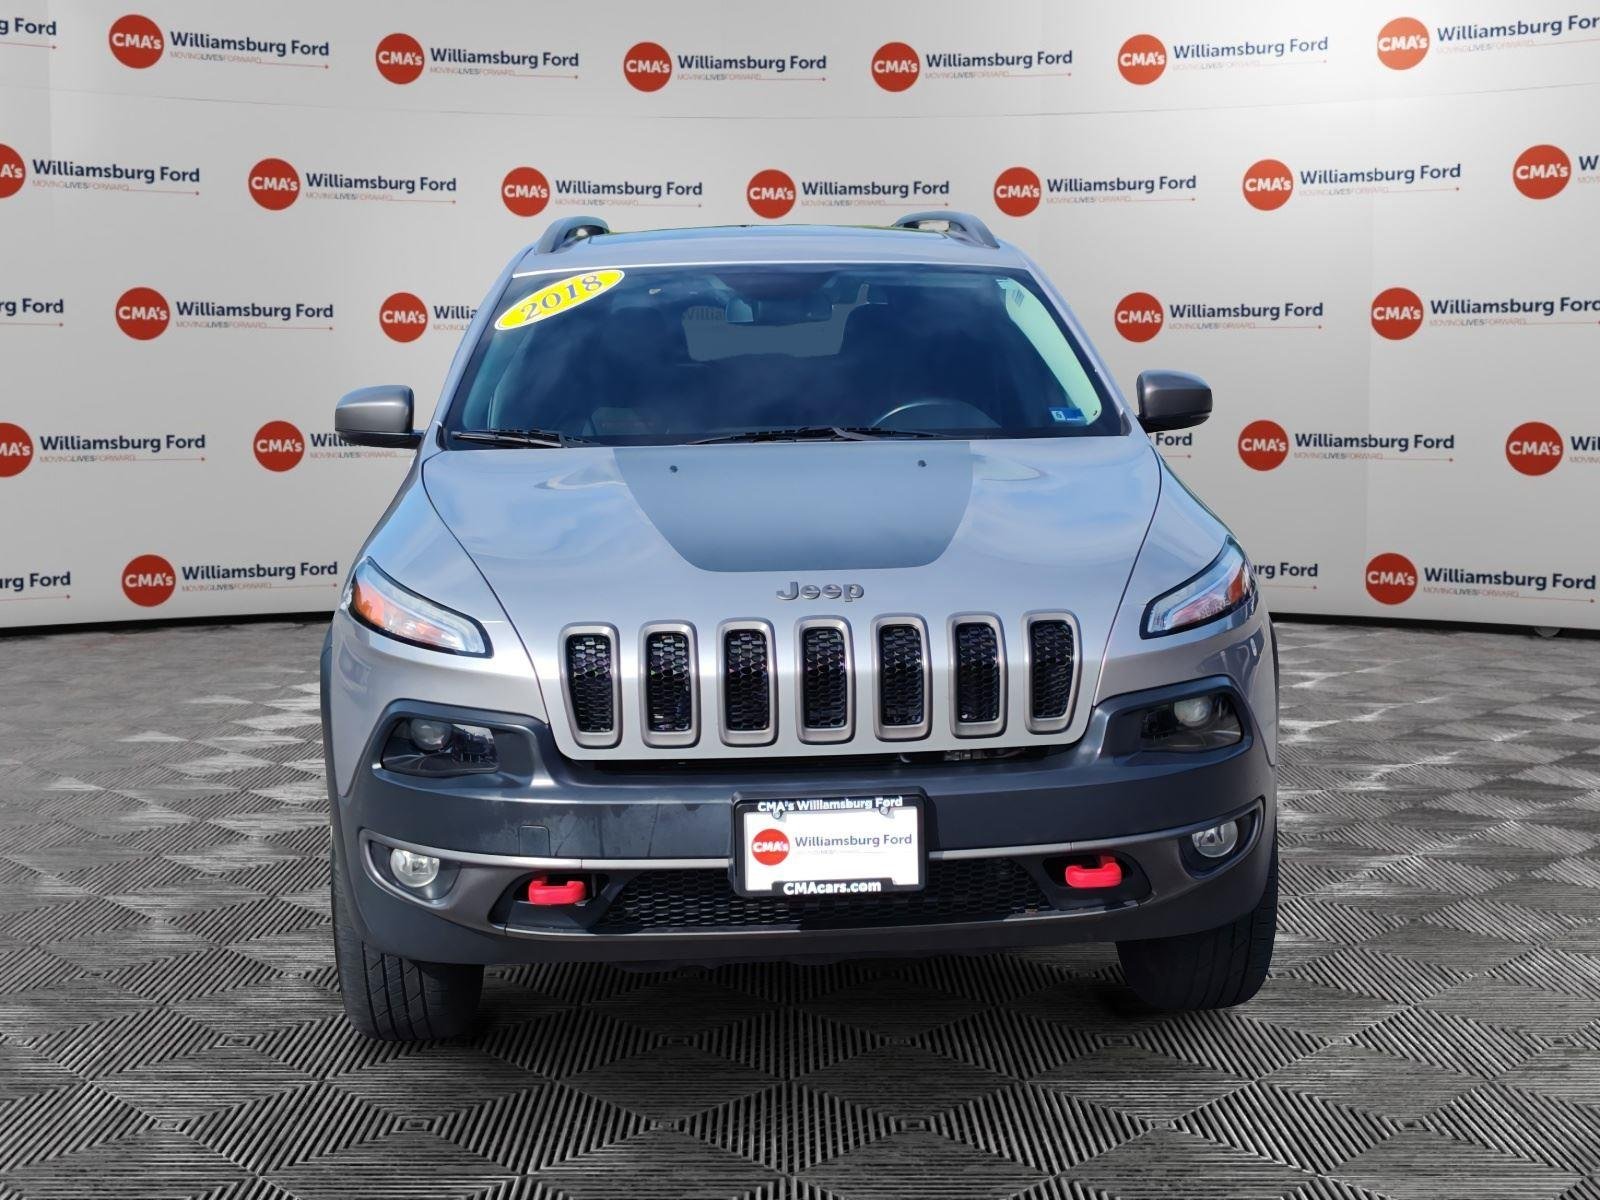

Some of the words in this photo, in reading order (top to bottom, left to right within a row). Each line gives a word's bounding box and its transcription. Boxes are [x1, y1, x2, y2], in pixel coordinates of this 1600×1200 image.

[15, 17, 57, 36] Ford
[1378, 34, 1428, 52] CMA's
[1437, 21, 1563, 42] Williamsburg
[1568, 14, 1600, 31] For
[111, 32, 163, 50] CMA's
[170, 31, 287, 58] Williamsburg
[291, 40, 330, 57] Ford
[1119, 50, 1165, 68] CMA's
[1173, 41, 1285, 60] Williamsburg
[1290, 36, 1329, 53] Ford
[378, 50, 424, 66] CMA's
[431, 48, 539, 70] Williamsburg
[543, 51, 580, 67] Ford
[626, 59, 671, 74] CMA's
[678, 55, 786, 73] Williamsburg
[790, 55, 827, 70] Ford
[873, 59, 918, 74] CMA's
[926, 53, 1033, 70] Williamsburg
[1038, 50, 1073, 66] Ford
[0, 163, 23, 179] A's
[33, 158, 156, 185] Williamsburg
[160, 166, 200, 183] Ford
[1245, 176, 1292, 193] CMA's
[1300, 168, 1416, 186] Williamsburg
[1420, 162, 1462, 180] Ford
[1515, 163, 1569, 180] CMA's
[251, 176, 299, 192] CMA's
[306, 172, 416, 195] Williamsburg
[420, 176, 457, 192] Ford
[503, 184, 549, 199] CMA's
[556, 180, 663, 200] Williamsburg
[667, 181, 703, 196] Ford
[749, 186, 795, 201] CMA's
[802, 181, 910, 199] Williamsburg
[914, 180, 950, 195] Ford
[995, 184, 1040, 199] CMA's
[1047, 177, 1155, 196] Williamsburg
[1159, 174, 1197, 190] Ford
[22, 297, 65, 314] Ford
[520, 275, 603, 321] 2018
[118, 306, 168, 321] CMA's
[176, 301, 292, 320] Williamsburg
[296, 303, 334, 319] Ford
[382, 310, 426, 324] CMA's
[1116, 310, 1162, 324] CMA's
[1170, 303, 1281, 322] Williamsburg
[1285, 302, 1324, 317] Ford
[1372, 306, 1422, 321] CMA's
[1431, 298, 1555, 317] Williamsburg
[0, 442, 31, 457] A's
[40, 435, 162, 454] Williamsburg
[166, 433, 206, 449] Ford
[256, 438, 304, 453] CMA's
[1155, 432, 1193, 447] Ford
[1240, 438, 1287, 453] CMA's
[1295, 433, 1410, 452] Williamsburg
[1414, 434, 1455, 450] Ford
[1508, 441, 1561, 456] CMA's
[30, 571, 71, 588] Ford
[125, 572, 174, 588] CMA's
[182, 564, 296, 581] Williamsburg
[301, 561, 338, 577] Ford
[1280, 562, 1318, 577] Ford
[1367, 571, 1416, 586] CMA's
[1424, 567, 1548, 592] Williamsburg
[1552, 572, 1597, 590] Ford
[776, 581, 865, 602] Jeep
[757, 801, 795, 812] CMA's
[798, 798, 873, 811] Williamsburg
[875, 796, 903, 808] Ford
[795, 835, 880, 848] Williamsburg
[883, 833, 912, 845] Ford
[783, 880, 882, 896] CMAcars.com
